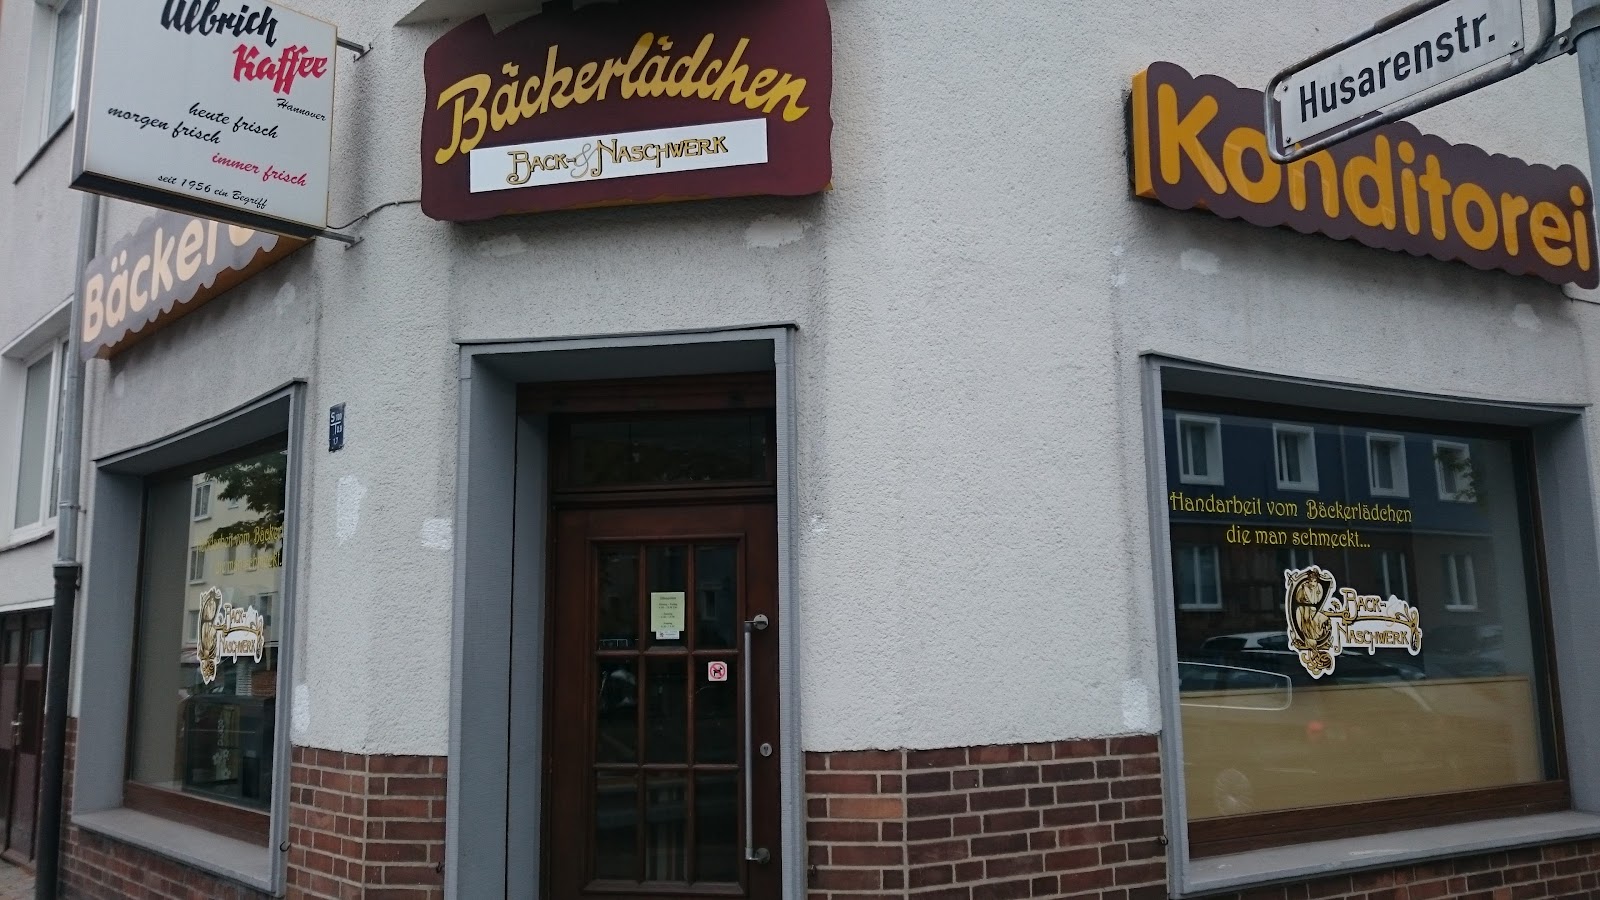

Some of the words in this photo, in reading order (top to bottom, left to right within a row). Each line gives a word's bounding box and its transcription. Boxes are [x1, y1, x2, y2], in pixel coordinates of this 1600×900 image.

[232, 44, 328, 95] Kaffee
[1299, 13, 1496, 123] Husarenstr.
[276, 98, 327, 121] Hannover
[435, 32, 810, 164] Bäckerlädchen
[107, 107, 169, 130] morgen
[171, 121, 221, 144] frisch
[188, 102, 231, 125] heute
[232, 116, 279, 139] frisch
[211, 152, 260, 174] immer
[262, 165, 308, 187] frisch
[589, 135, 730, 178] NASCHWERK
[157, 175, 178, 185] seit
[180, 179, 212, 193] 1956
[213, 188, 229, 197] ein
[231, 190, 268, 210] Begriff
[1157, 83, 1590, 272] Konditorei
[1169, 491, 1262, 517] Handarbeit
[1266, 501, 1298, 517] vom
[1306, 499, 1413, 524] Bäckerlädchen
[1226, 523, 1252, 546] die
[1255, 530, 1288, 546] man
[1291, 527, 1371, 549] schmeckt...
